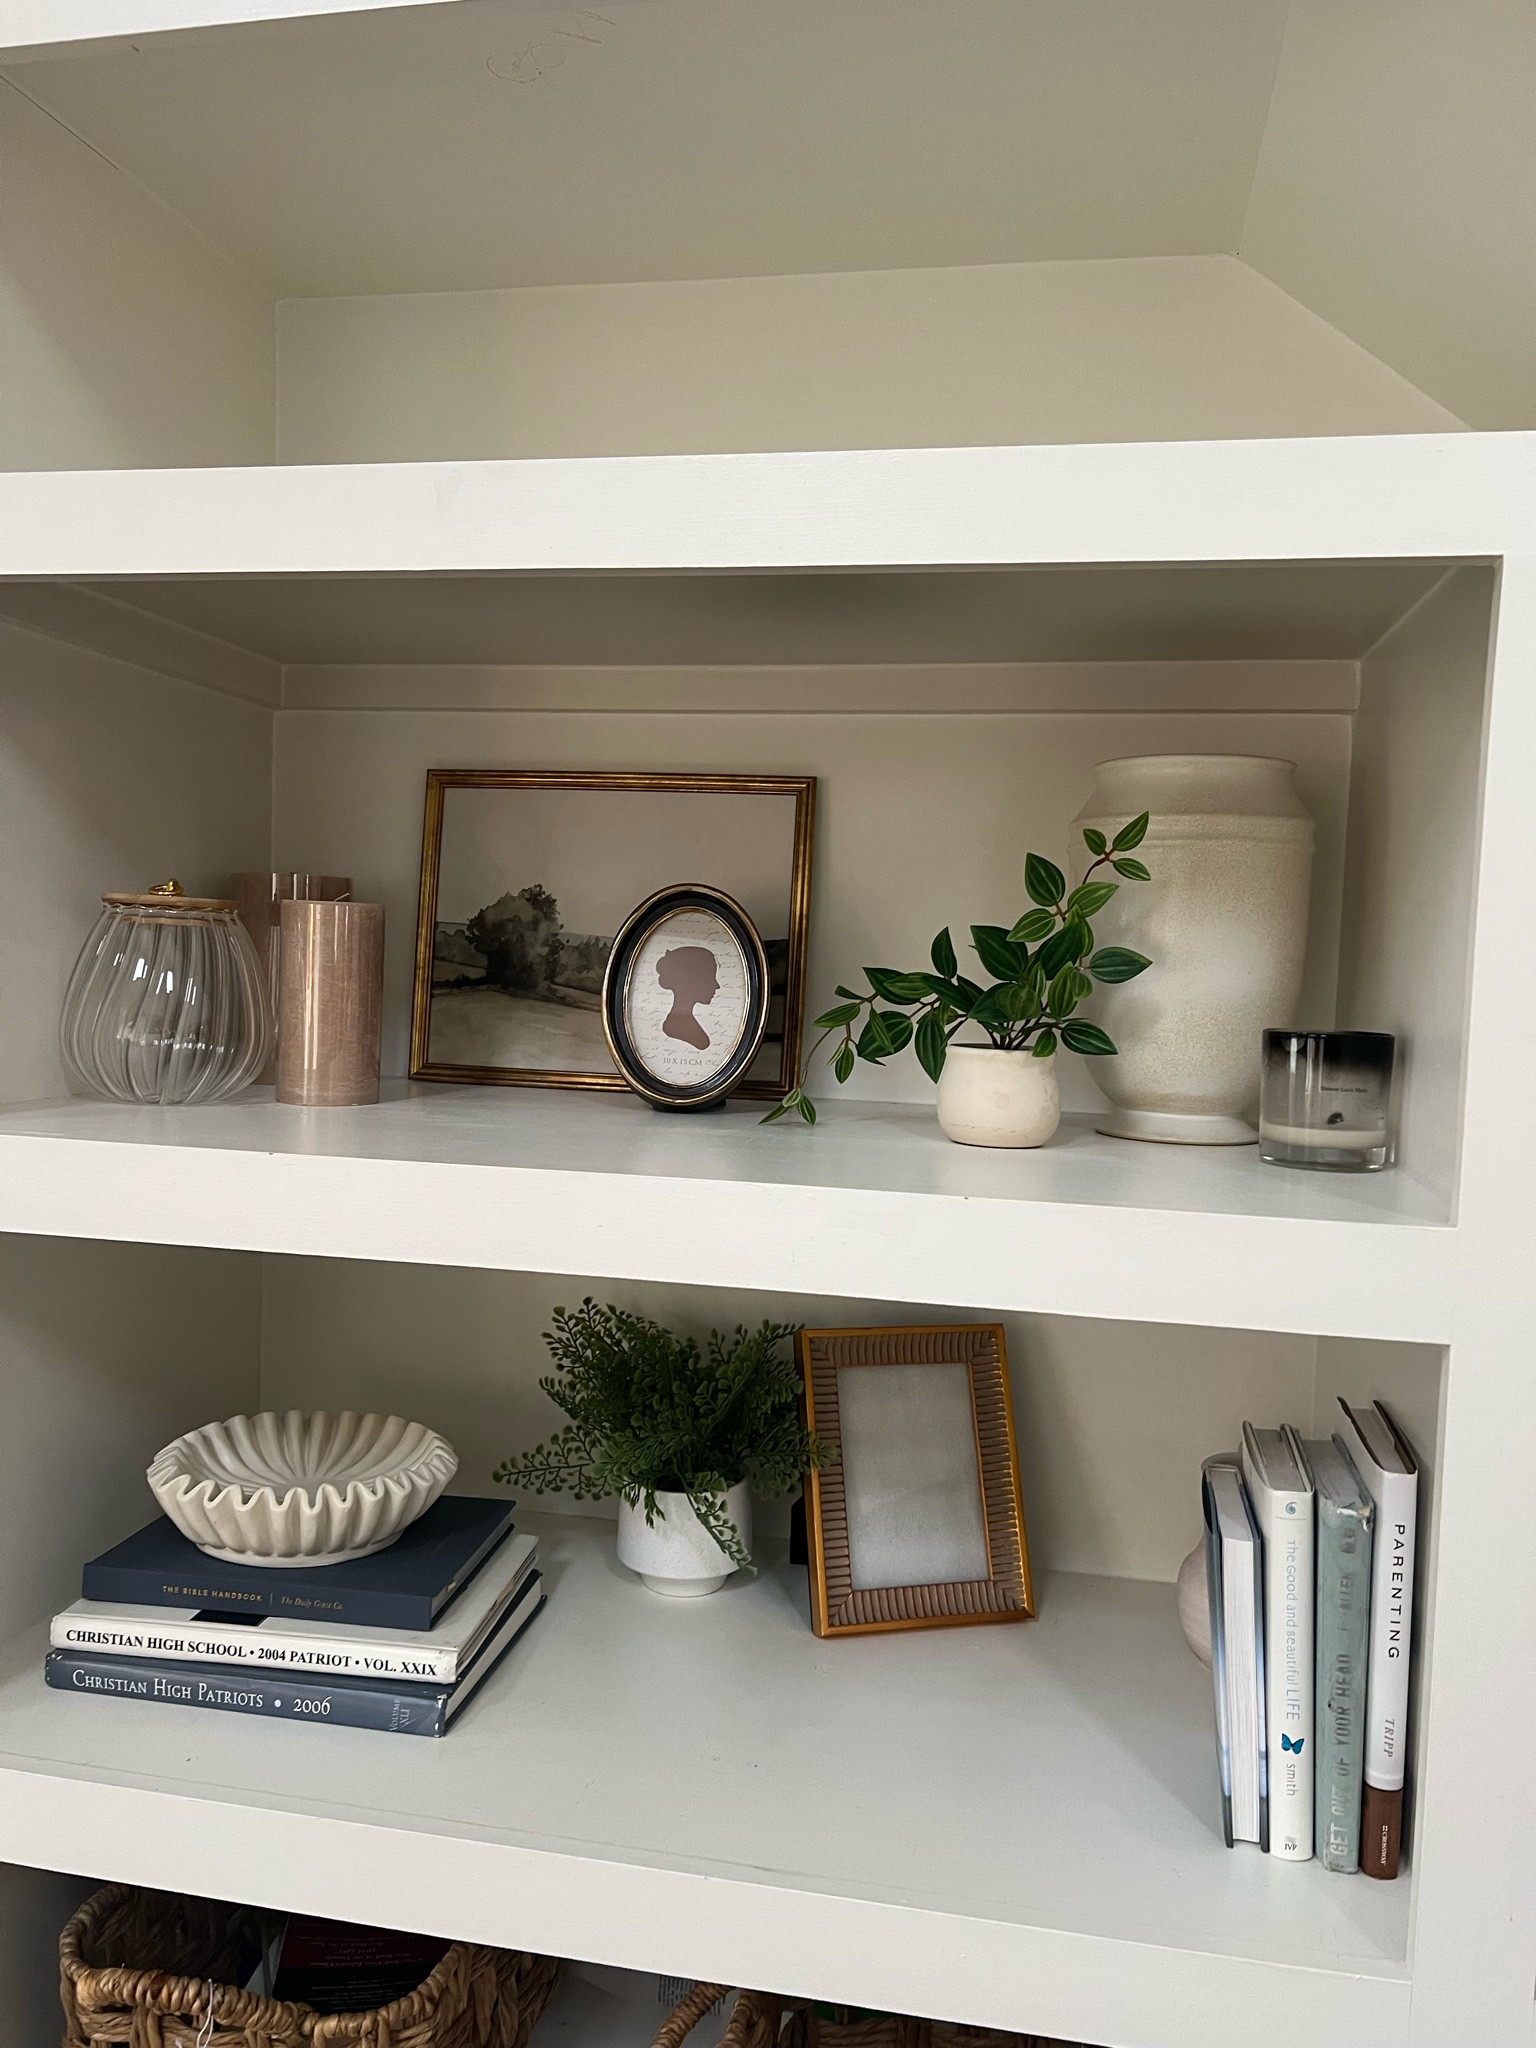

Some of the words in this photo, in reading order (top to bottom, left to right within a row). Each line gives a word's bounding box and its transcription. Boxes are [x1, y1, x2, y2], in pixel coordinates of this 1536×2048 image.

[1286, 1540, 1299, 1562] The
[162, 1585, 180, 1594] THE
[183, 1587, 209, 1597] BIBLE
[212, 1591, 263, 1602] HANDBOOK
[1286, 1565, 1299, 1601] Good
[1388, 1524, 1406, 1659] PARENTING
[1286, 1604, 1299, 1628] and
[66, 1629, 143, 1647] CHRISTIAN
[147, 1637, 184, 1651] HIGH
[187, 1641, 247, 1657] SCHOOL
[257, 1648, 286, 1661] 2004
[289, 1650, 353, 1668] PATRIOT
[364, 1658, 397, 1672] VOL.
[400, 1661, 437, 1676] XXIX
[1335, 1653, 1350, 1699] HEAD
[292, 1696, 332, 1715] 2006
[1286, 1690, 1300, 1720] LIFE
[1335, 1704, 1351, 1746] YOUR
[1383, 1718, 1395, 1758] TRIPP
[1330, 1822, 1350, 1856] GET
